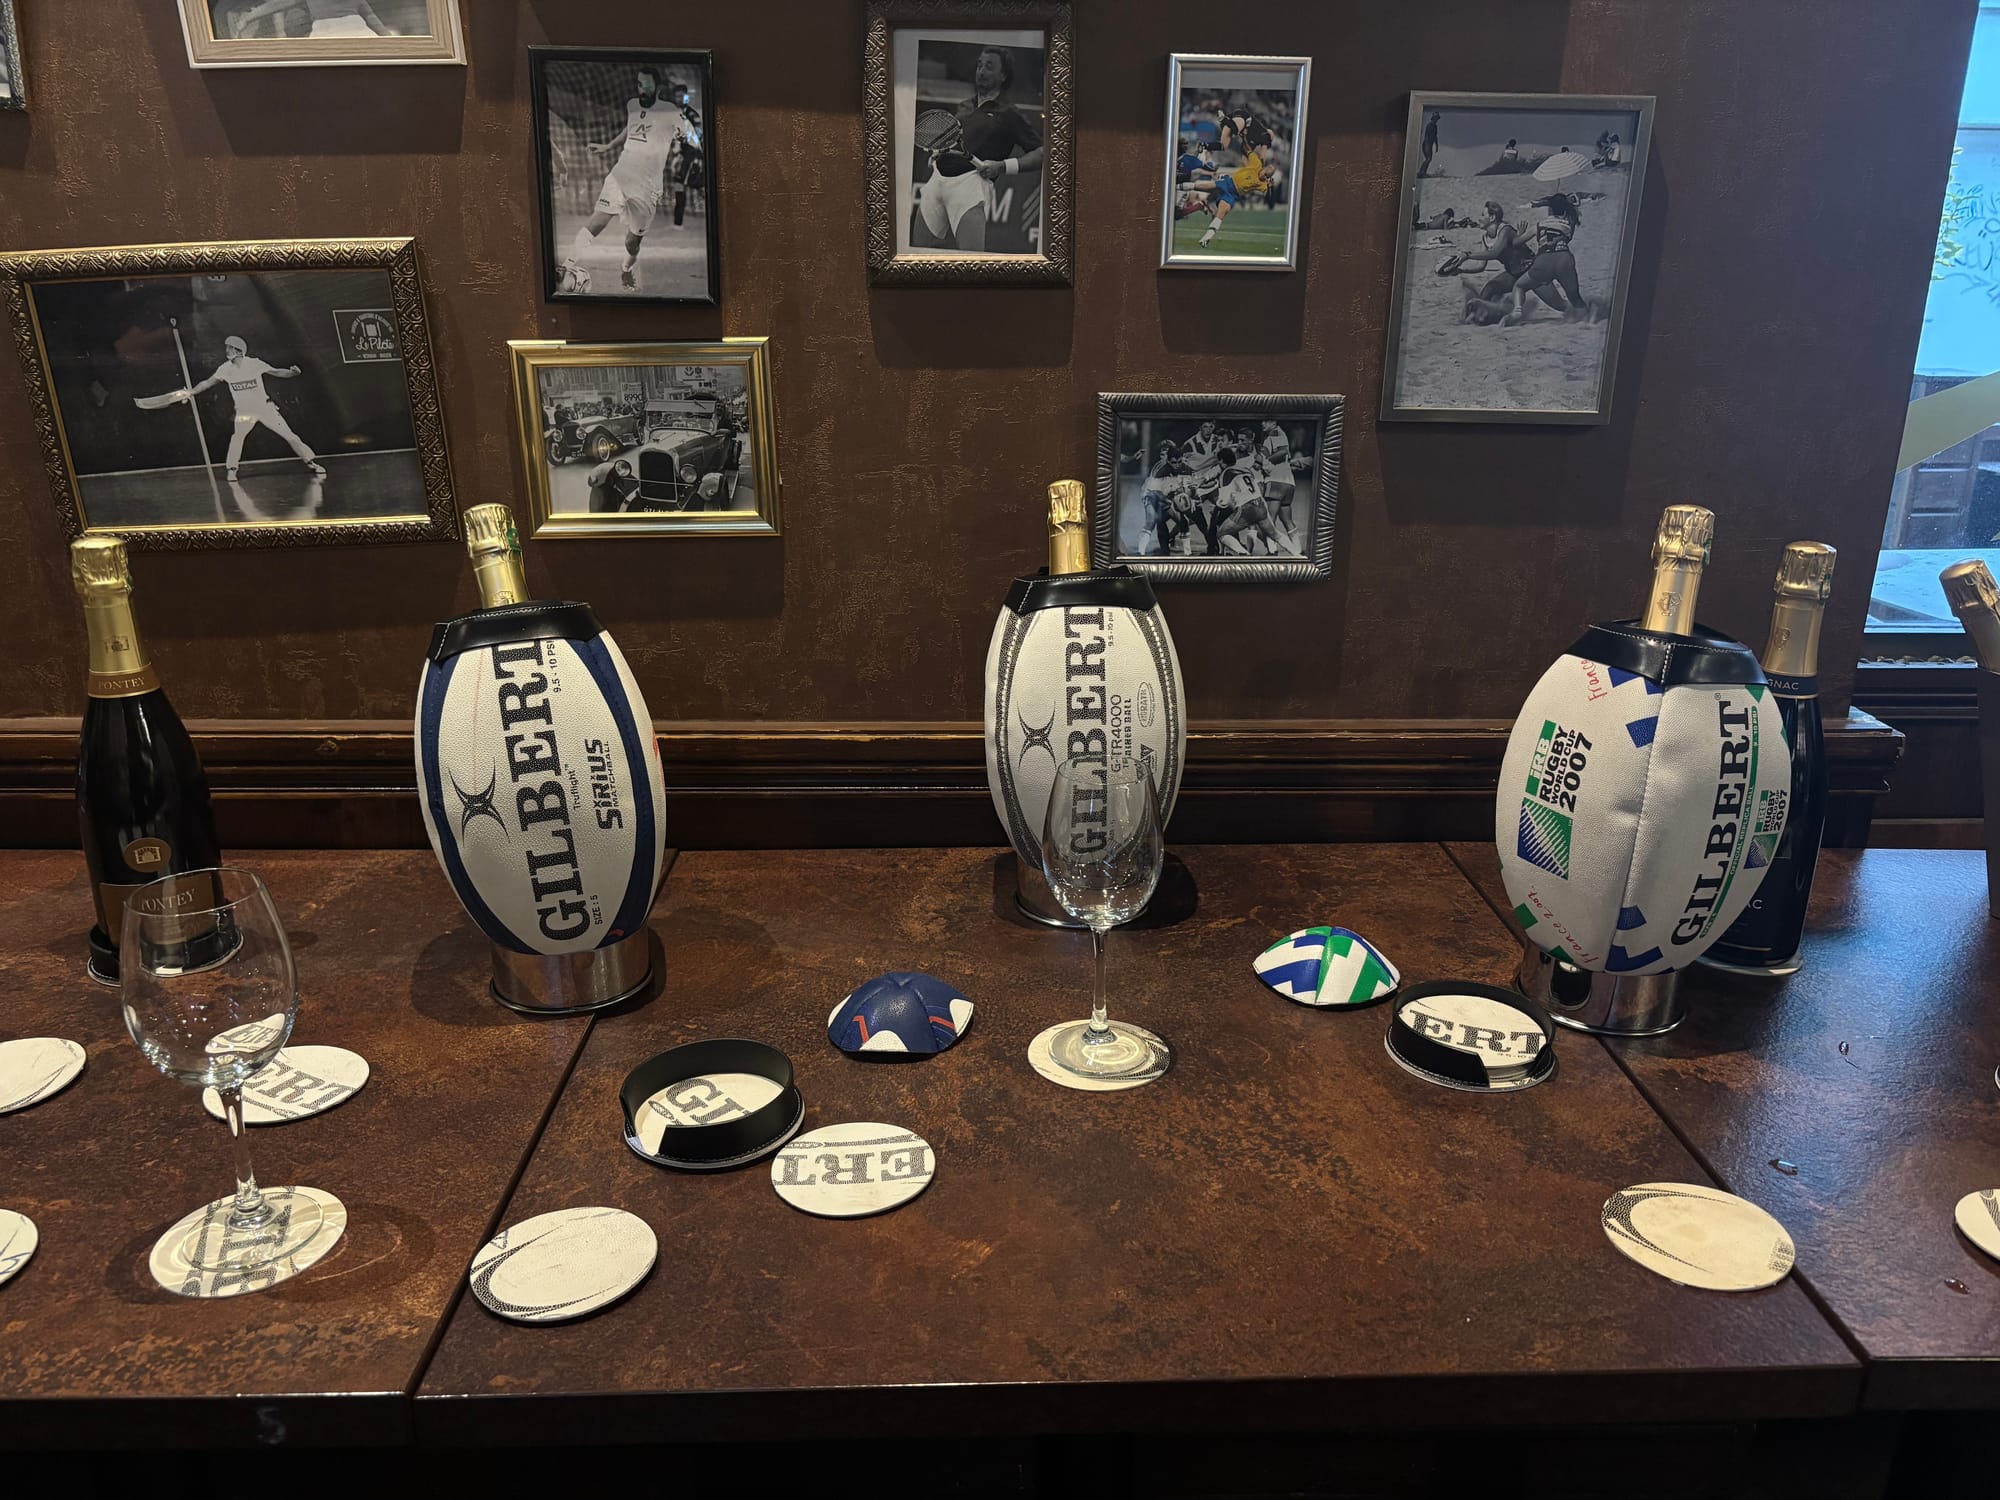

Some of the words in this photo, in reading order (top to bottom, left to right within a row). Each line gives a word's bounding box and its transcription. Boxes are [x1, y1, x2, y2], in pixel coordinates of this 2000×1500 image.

[1243, 476, 1256, 493] 9
[546, 640, 556, 656] PSI
[548, 658, 558, 669] 10
[552, 678, 562, 693] 9.5
[1063, 607, 1107, 854] GILBERT
[1110, 694, 1122, 773] G-TR4000
[1539, 725, 1568, 802] RUGBY
[1550, 757, 1568, 804] WORLD
[1563, 729, 1577, 756] CUP
[1559, 732, 1593, 813] 2007
[491, 639, 591, 941] GILBERT
[1763, 790, 1777, 832] RUGBY
[1773, 789, 1788, 832] 2007
[594, 909, 604, 925] SIZE
[1409, 1009, 1547, 1055] ERT
[665, 1078, 752, 1125] GI
[774, 1145, 932, 1186] ERT
